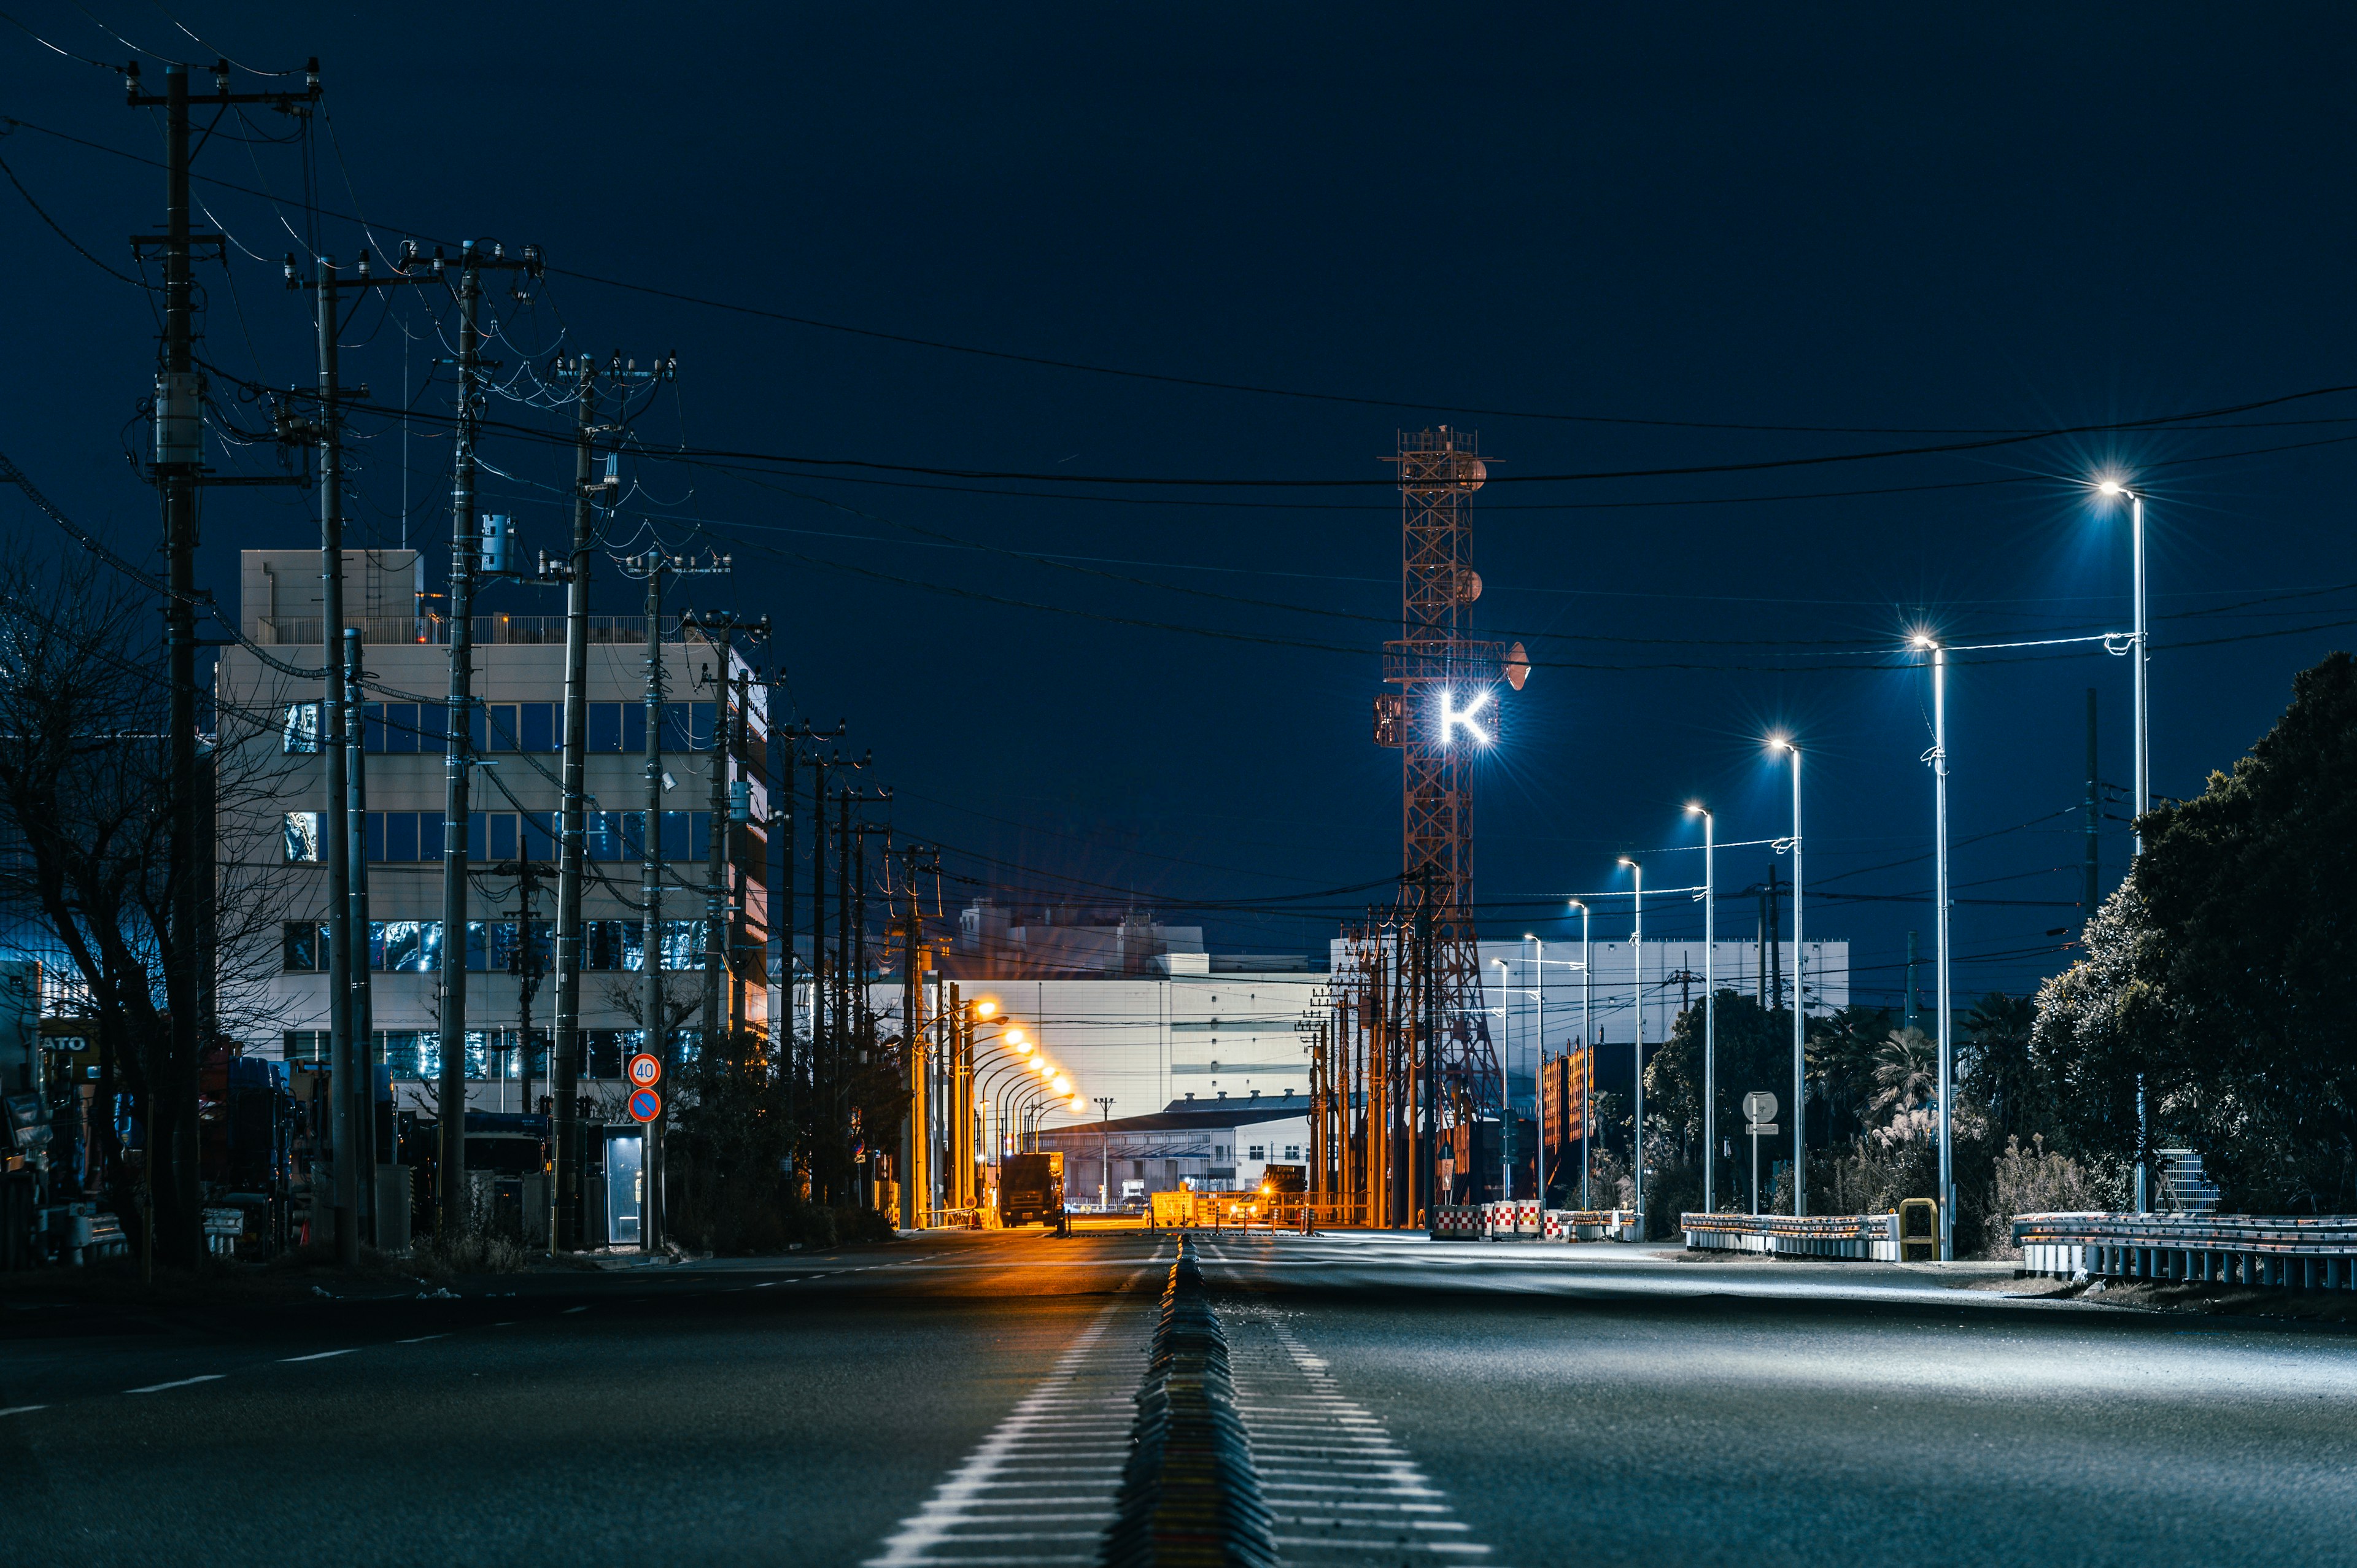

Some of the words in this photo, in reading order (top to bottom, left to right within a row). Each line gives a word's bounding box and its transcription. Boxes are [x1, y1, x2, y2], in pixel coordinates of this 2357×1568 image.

[1441, 692, 1488, 743] K
[39, 1036, 85, 1051] ATO
[637, 1064, 653, 1078] 40
